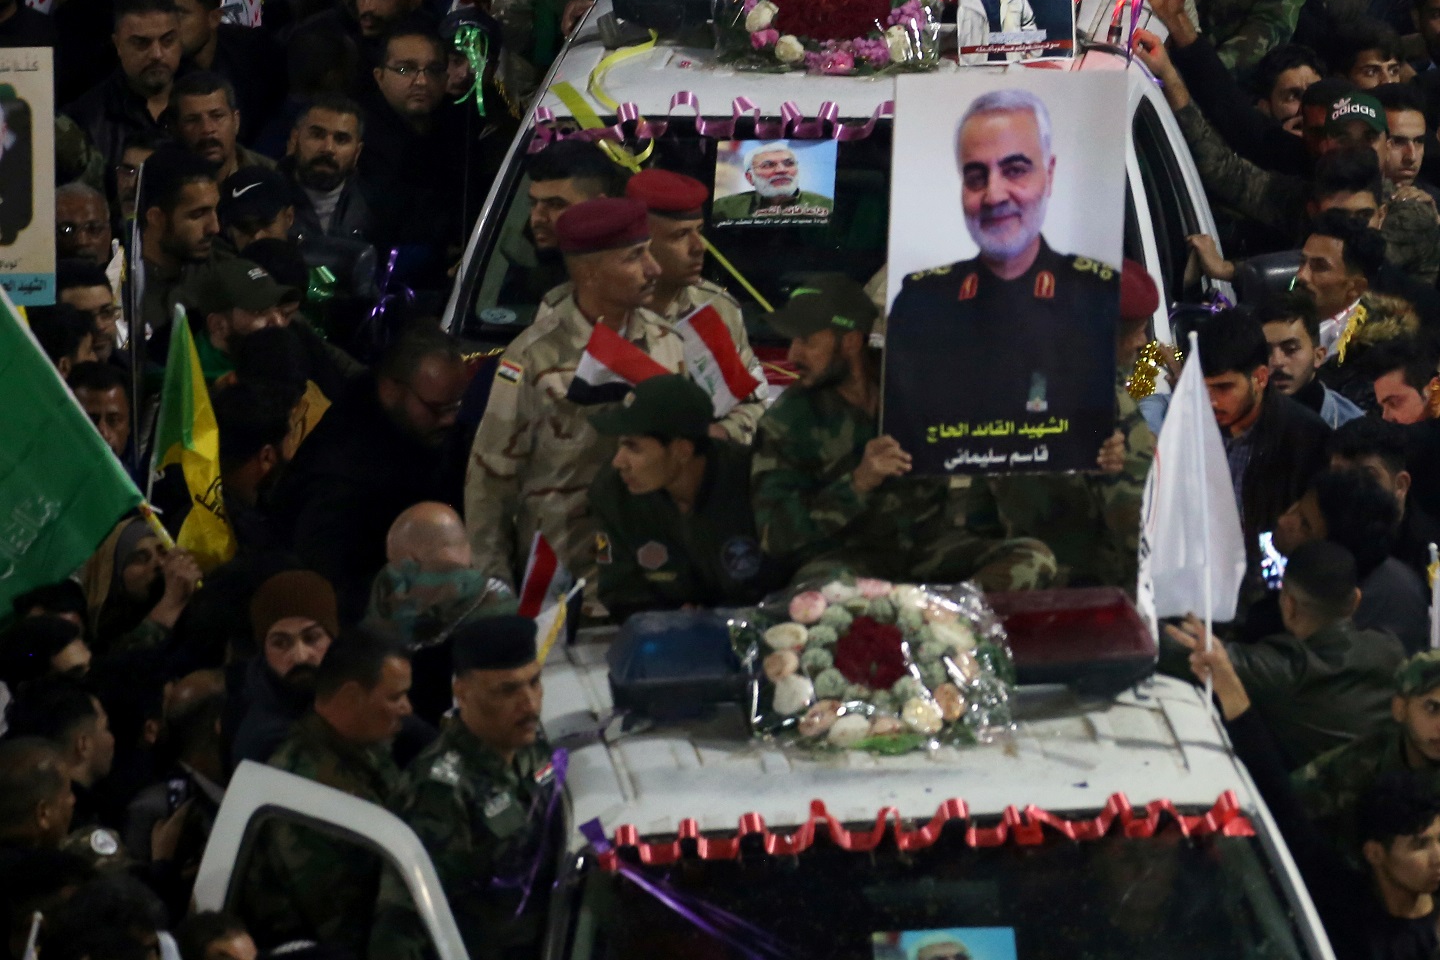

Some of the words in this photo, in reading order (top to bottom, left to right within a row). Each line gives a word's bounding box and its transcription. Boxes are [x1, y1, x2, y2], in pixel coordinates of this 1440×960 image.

[1331, 103, 1376, 120] adidas
[926, 421, 970, 444] الحاج
[971, 419, 1015, 437] القائد
[1017, 416, 1069, 439] الشهيد
[1008, 444, 1050, 468] قاسم
